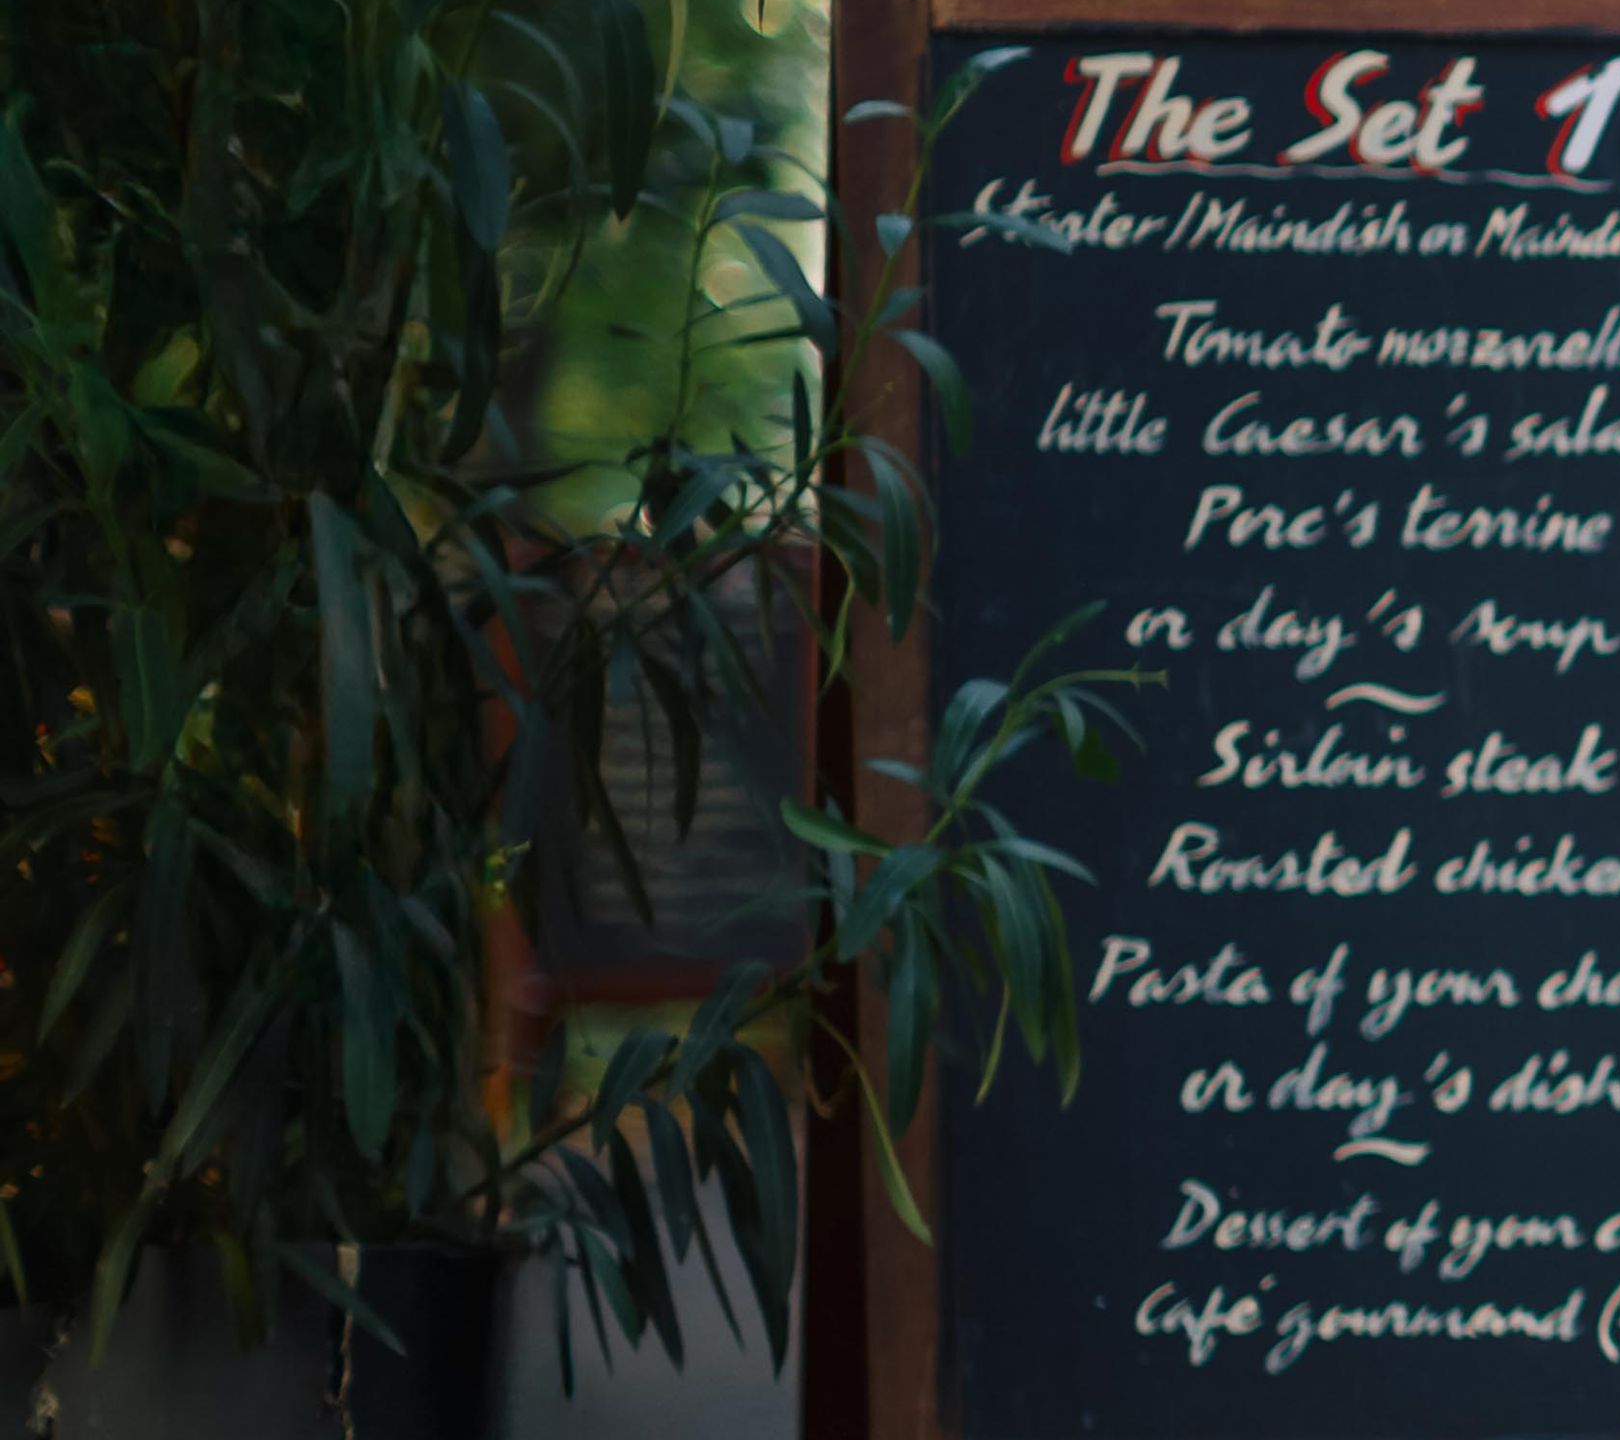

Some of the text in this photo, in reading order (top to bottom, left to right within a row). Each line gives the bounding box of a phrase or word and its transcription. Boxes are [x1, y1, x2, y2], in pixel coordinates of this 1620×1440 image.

[1060, 50, 1253, 166] The
[1275, 48, 1484, 174] Set
[1418, 222, 1468, 254] or
[1155, 300, 1372, 370] Tomato
[1183, 483, 1613, 552] Porc's terrine
[1126, 606, 1192, 651] or
[1216, 584, 1422, 679] day's
[1197, 720, 1619, 798] Sirloin steak
[1148, 822, 1418, 896] Roasted
[1088, 935, 1272, 1007] Pasta
[1290, 942, 1350, 1035] of
[1359, 963, 1520, 1041] your
[1180, 1060, 1256, 1113] or
[1267, 1040, 1473, 1138] day's
[1160, 1178, 1380, 1250] Dessert
[1385, 1198, 1440, 1272] of
[1439, 1212, 1585, 1280] your
[1134, 1274, 1277, 1366] Café
[1264, 1287, 1586, 1374] gourmand
